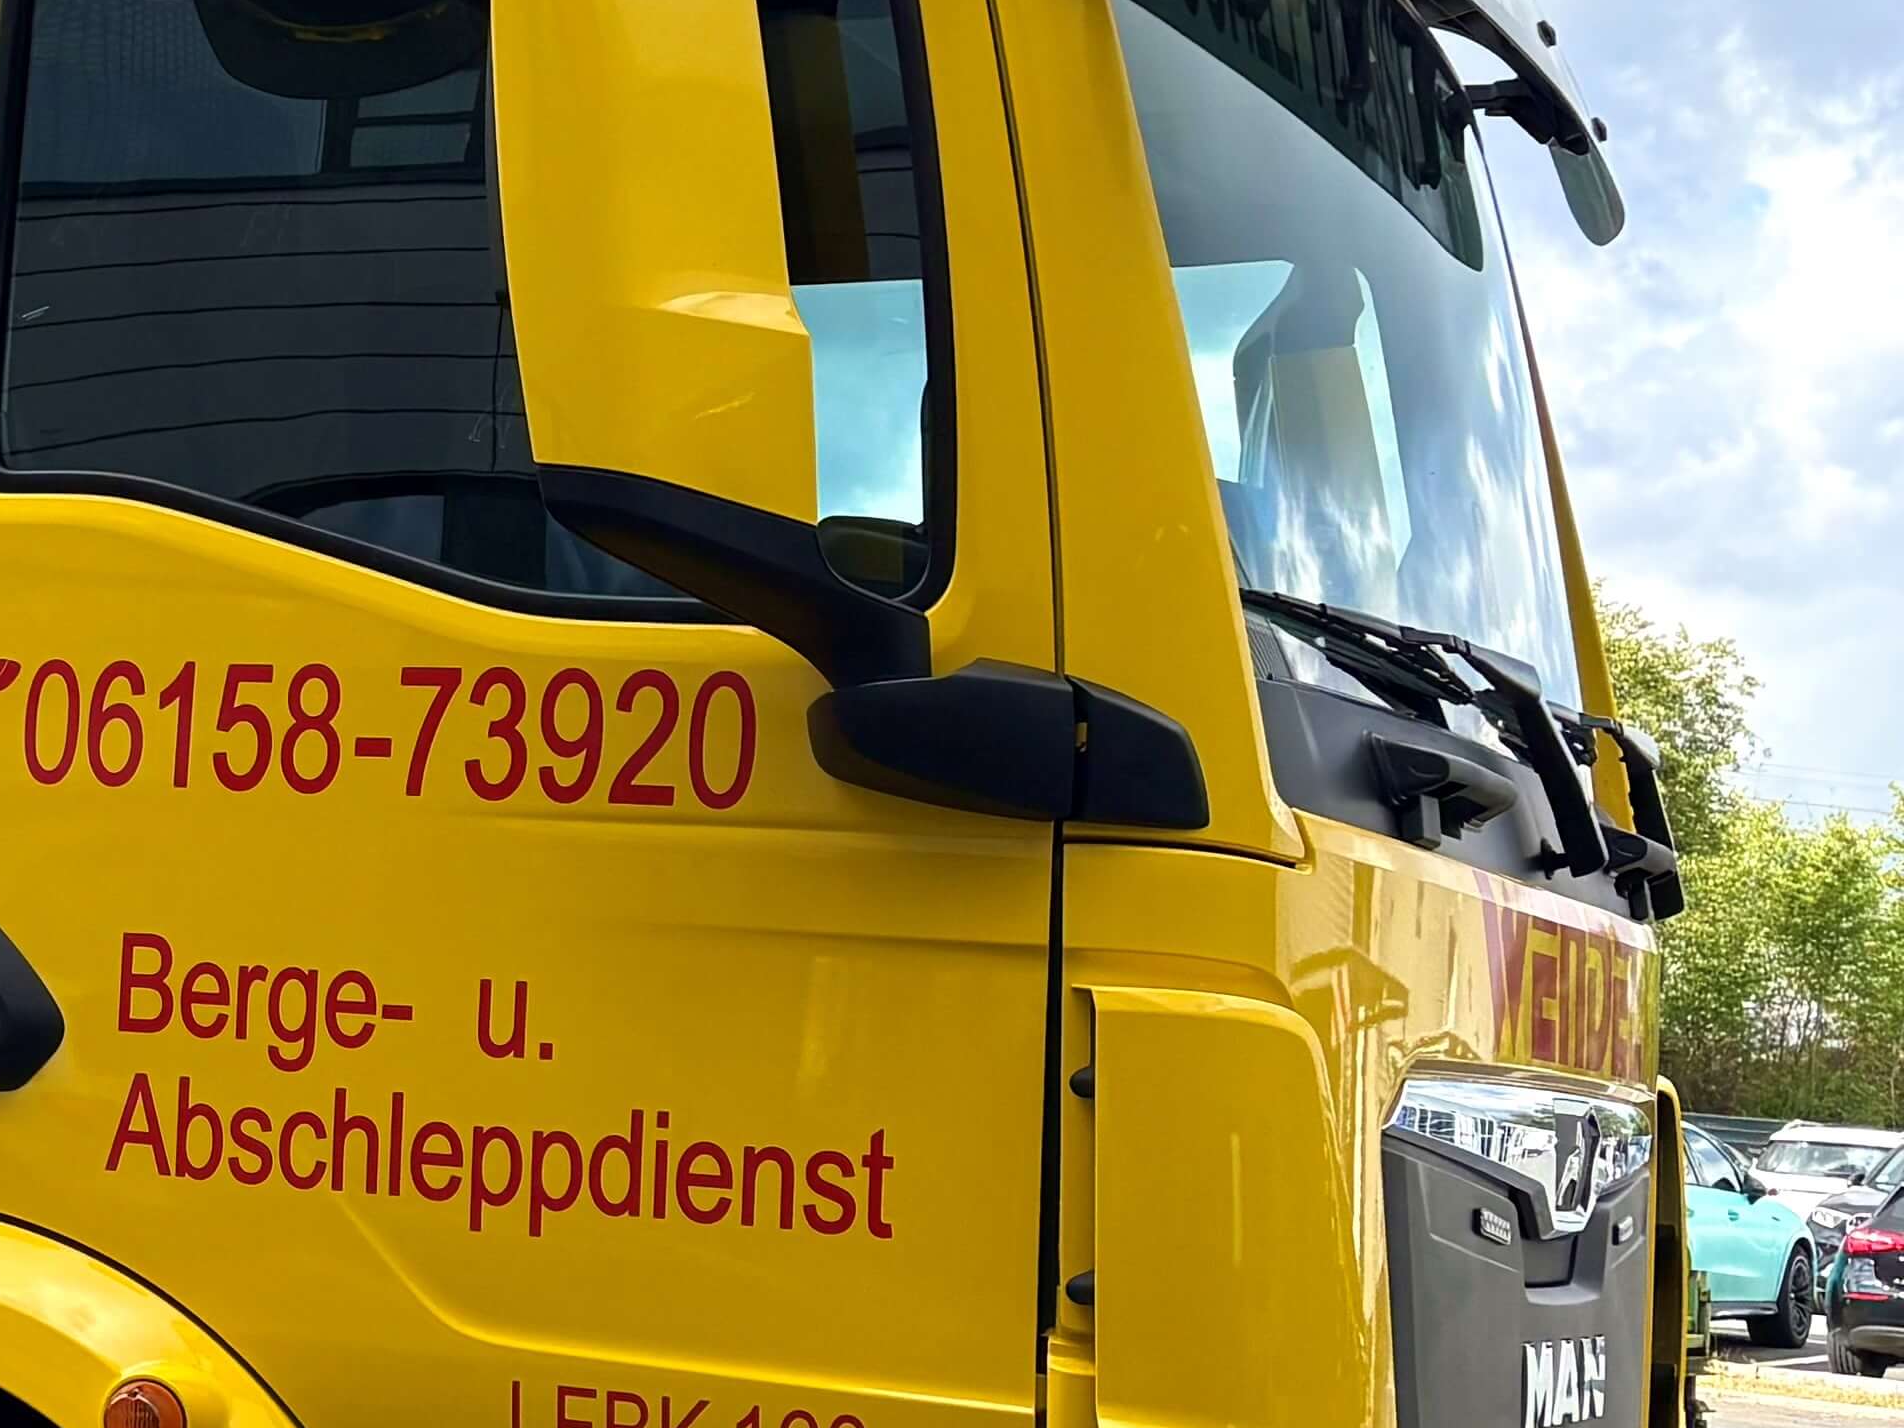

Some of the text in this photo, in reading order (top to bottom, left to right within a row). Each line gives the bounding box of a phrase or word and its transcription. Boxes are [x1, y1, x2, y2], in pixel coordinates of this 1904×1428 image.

[23, 656, 758, 811] 06158-73920
[116, 932, 556, 1074] Berge- u.
[103, 1071, 896, 1240] Abschleppdienst
